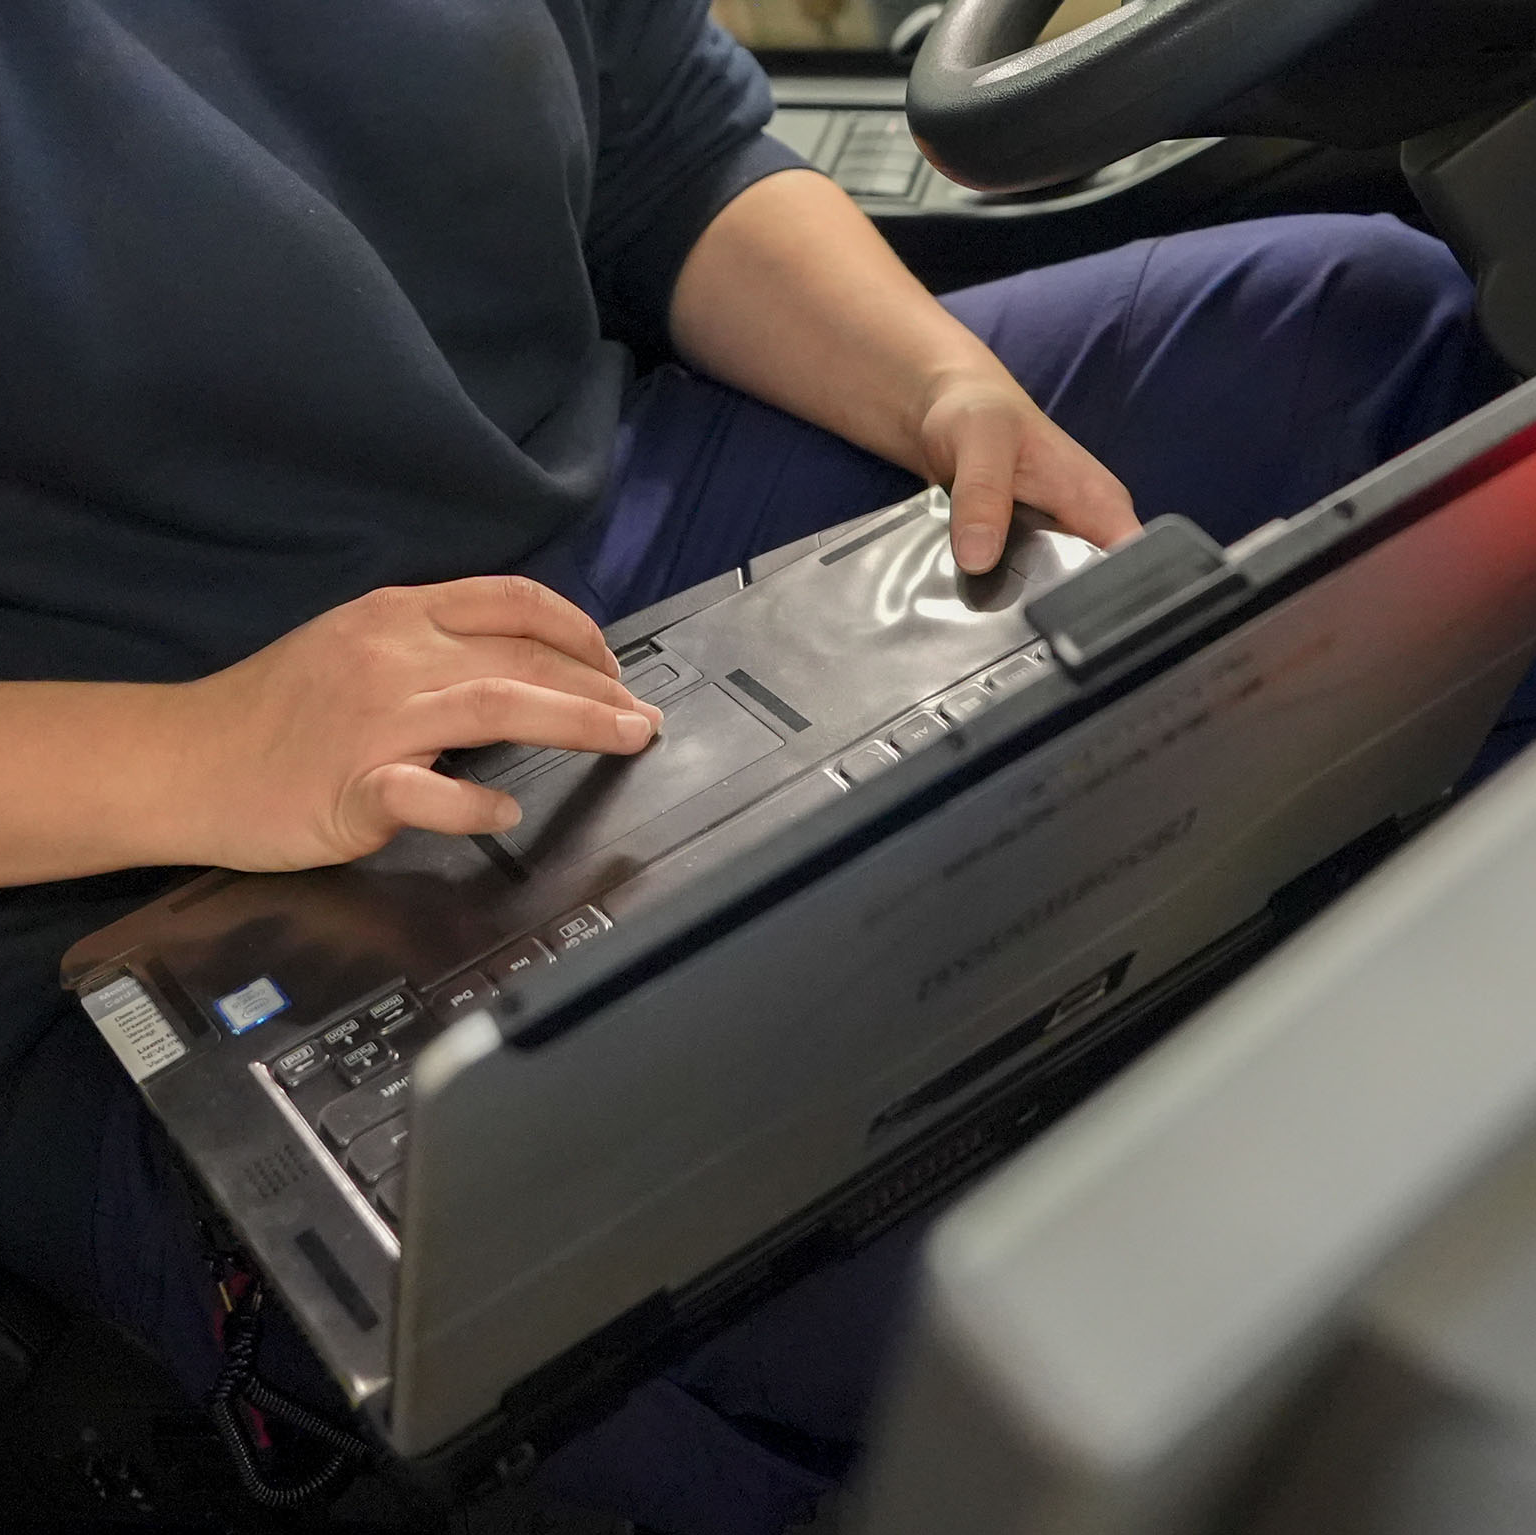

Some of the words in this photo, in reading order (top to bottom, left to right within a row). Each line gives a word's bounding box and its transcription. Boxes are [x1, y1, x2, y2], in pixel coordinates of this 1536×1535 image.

[580, 925, 599, 939] Alt
[563, 936, 581, 950] Gr
[509, 956, 531, 971] Ins
[373, 995, 402, 1016] Home
[450, 989, 474, 1007] Del
[283, 1046, 311, 1066] End
[379, 1075, 409, 1098] hift
